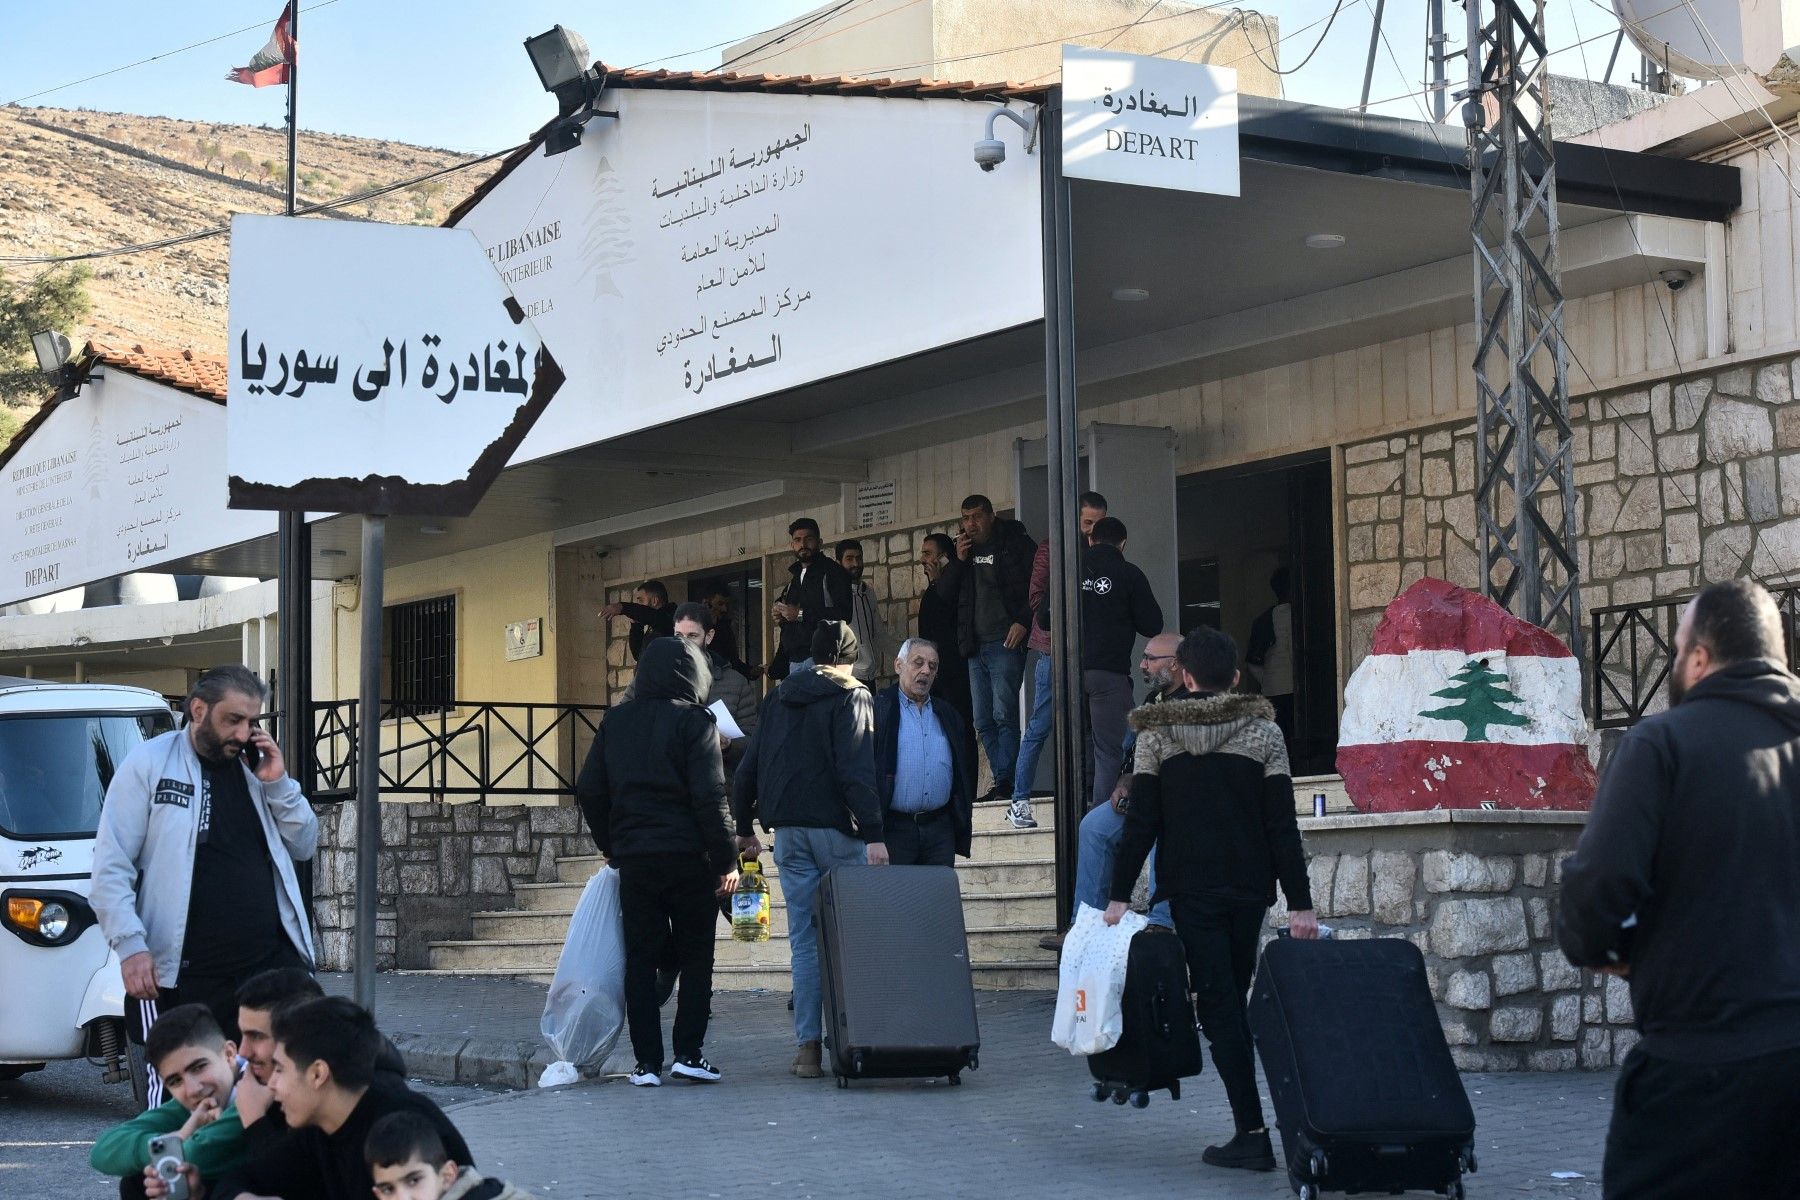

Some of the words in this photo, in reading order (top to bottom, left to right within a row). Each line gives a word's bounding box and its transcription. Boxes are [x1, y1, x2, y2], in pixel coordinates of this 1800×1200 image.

[1102, 87, 1197, 118] المغادرة
[730, 123, 811, 169] الجمهورية
[1105, 128, 1199, 161] DEPART
[652, 156, 725, 199] اللبنانية
[720, 174, 769, 208] الداخلية
[772, 165, 804, 191] وزارة
[659, 197, 717, 229] والبلديات
[498, 221, 562, 262] LIBANAISE
[681, 234, 720, 263] العامة
[724, 213, 780, 251] المديرية
[501, 255, 553, 286] 'INTERIEUR
[696, 266, 725, 300] العام
[527, 301, 540, 319] DE
[541, 298, 554, 314] LA
[711, 296, 767, 339] المصنع
[772, 287, 812, 318] مركز
[656, 314, 707, 357] الحدودي
[241, 328, 339, 398] سوريا
[684, 332, 783, 395] المغادرة
[25, 562, 61, 588] DEPART
[156, 794, 188, 806] PLEIN
